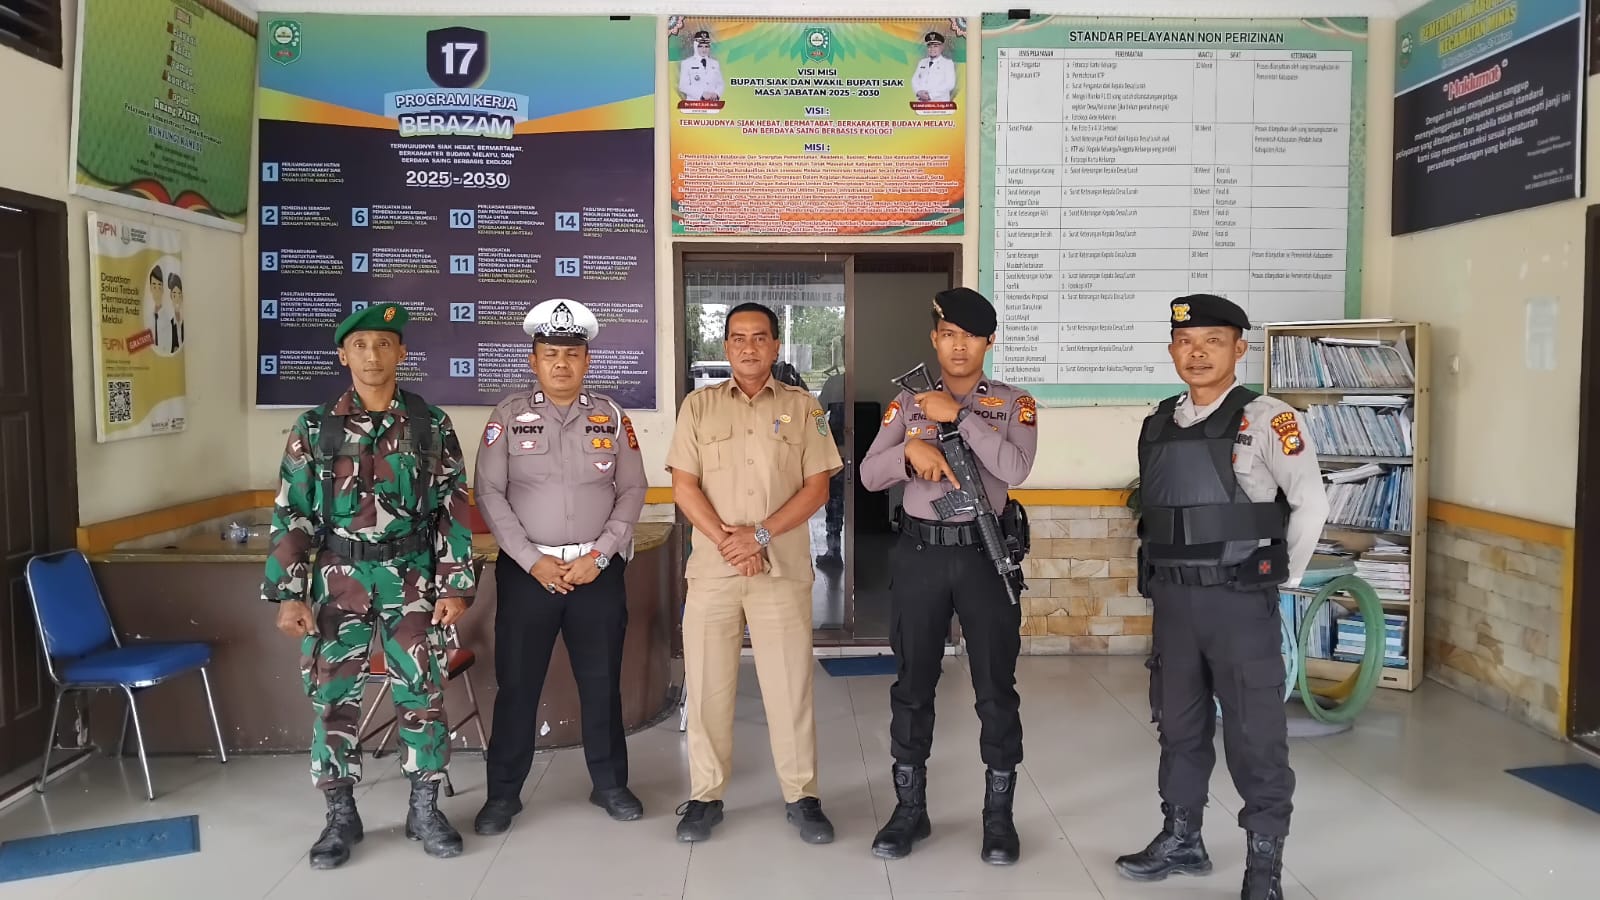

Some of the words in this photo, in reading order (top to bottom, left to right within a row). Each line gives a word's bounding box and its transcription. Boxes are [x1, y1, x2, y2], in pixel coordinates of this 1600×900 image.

[1069, 31, 1123, 42] STANDAR
[1126, 32, 1195, 42] PELAYANAN
[1198, 32, 1222, 42] NON
[1225, 32, 1284, 43] PERIZINAN
[442, 42, 478, 75] 17
[395, 93, 471, 108] PROGRAM
[473, 94, 517, 110] KERJA
[1454, 104, 1467, 115] kami
[1504, 80, 1529, 96] sanggup
[1496, 98, 1514, 112] sesuai
[1515, 86, 1544, 106] standard
[154, 98, 176, 117] Ruang
[178, 107, 200, 126] PATEN
[1464, 127, 1475, 136] Dan
[1545, 94, 1561, 111] janji
[401, 114, 512, 136] BERAZAM
[1507, 118, 1538, 136] peraturan
[804, 143, 825, 151] MISI
[267, 165, 273, 179] 1
[406, 170, 450, 186] 2025
[463, 172, 508, 188] 2030
[264, 208, 275, 223] 2
[354, 210, 365, 224] 6
[452, 212, 472, 226] 10
[557, 215, 577, 228] 14
[264, 254, 275, 269] 3
[355, 256, 365, 270] 7
[454, 258, 469, 272] 11
[558, 260, 576, 274] 15
[263, 302, 275, 316] 4
[453, 306, 471, 320] 12
[264, 358, 274, 372] 5
[453, 361, 471, 374] 13
[512, 425, 544, 435] VICKY
[585, 425, 616, 435] POLRI
